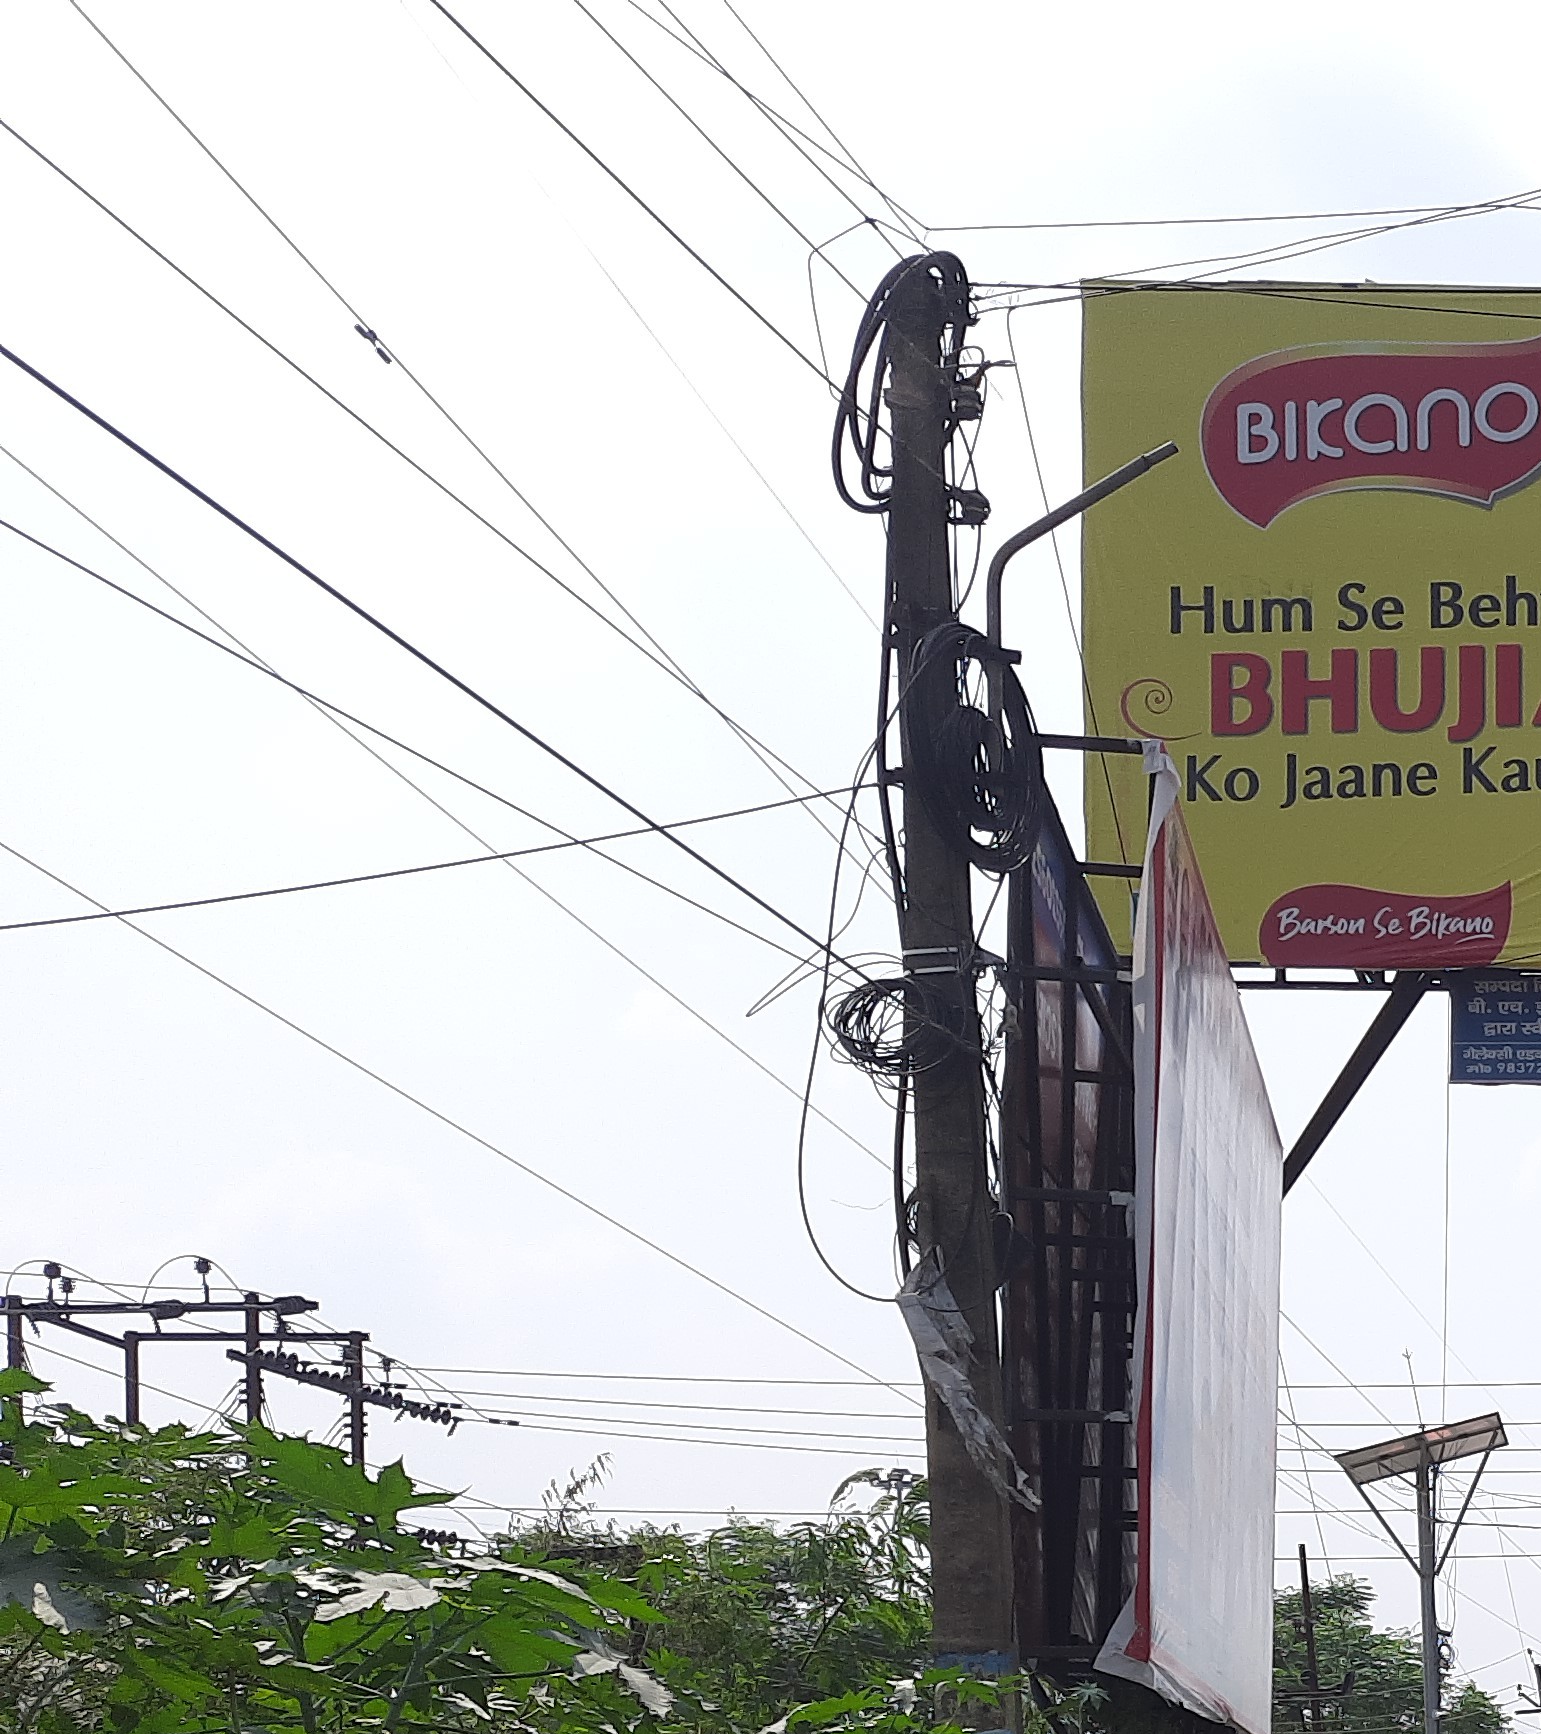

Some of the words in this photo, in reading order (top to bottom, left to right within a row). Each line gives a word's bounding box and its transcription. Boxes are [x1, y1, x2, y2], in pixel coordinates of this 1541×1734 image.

[1169, 585, 1313, 634] Hum
[1337, 582, 1405, 632] Se
[1185, 754, 1260, 803] Ko
[1279, 752, 1438, 809] Jaane
[1276, 907, 1367, 940] Barson
[1372, 907, 1402, 937] Se
[1406, 910, 1495, 938] Bikano
